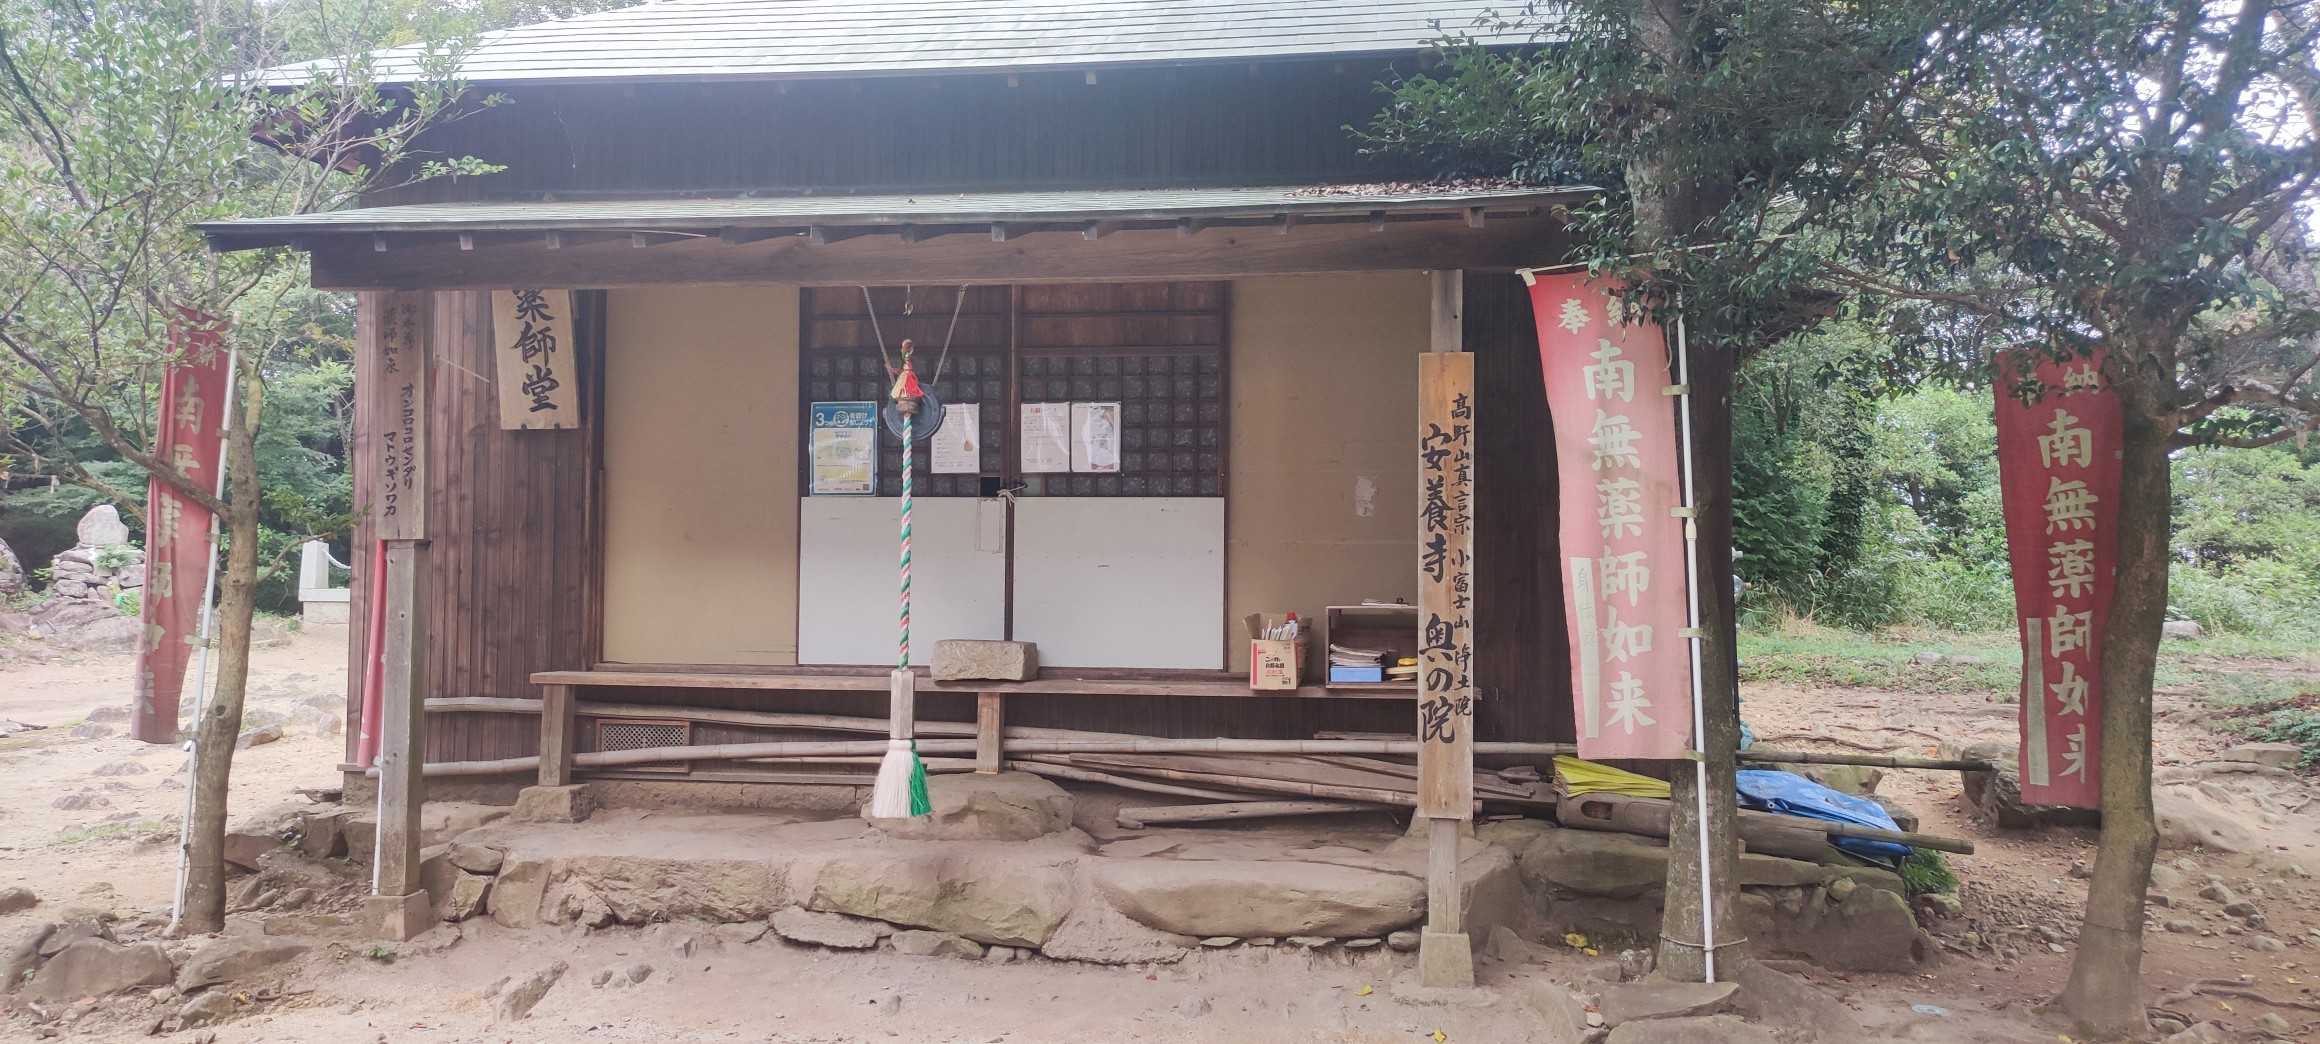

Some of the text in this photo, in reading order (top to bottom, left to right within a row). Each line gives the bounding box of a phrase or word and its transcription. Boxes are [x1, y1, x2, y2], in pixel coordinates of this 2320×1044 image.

[1419, 422, 1457, 744] 安養寺 奥の院
[1451, 548, 1471, 630] 小富士山
[1582, 337, 1657, 736] 南無薬師如来
